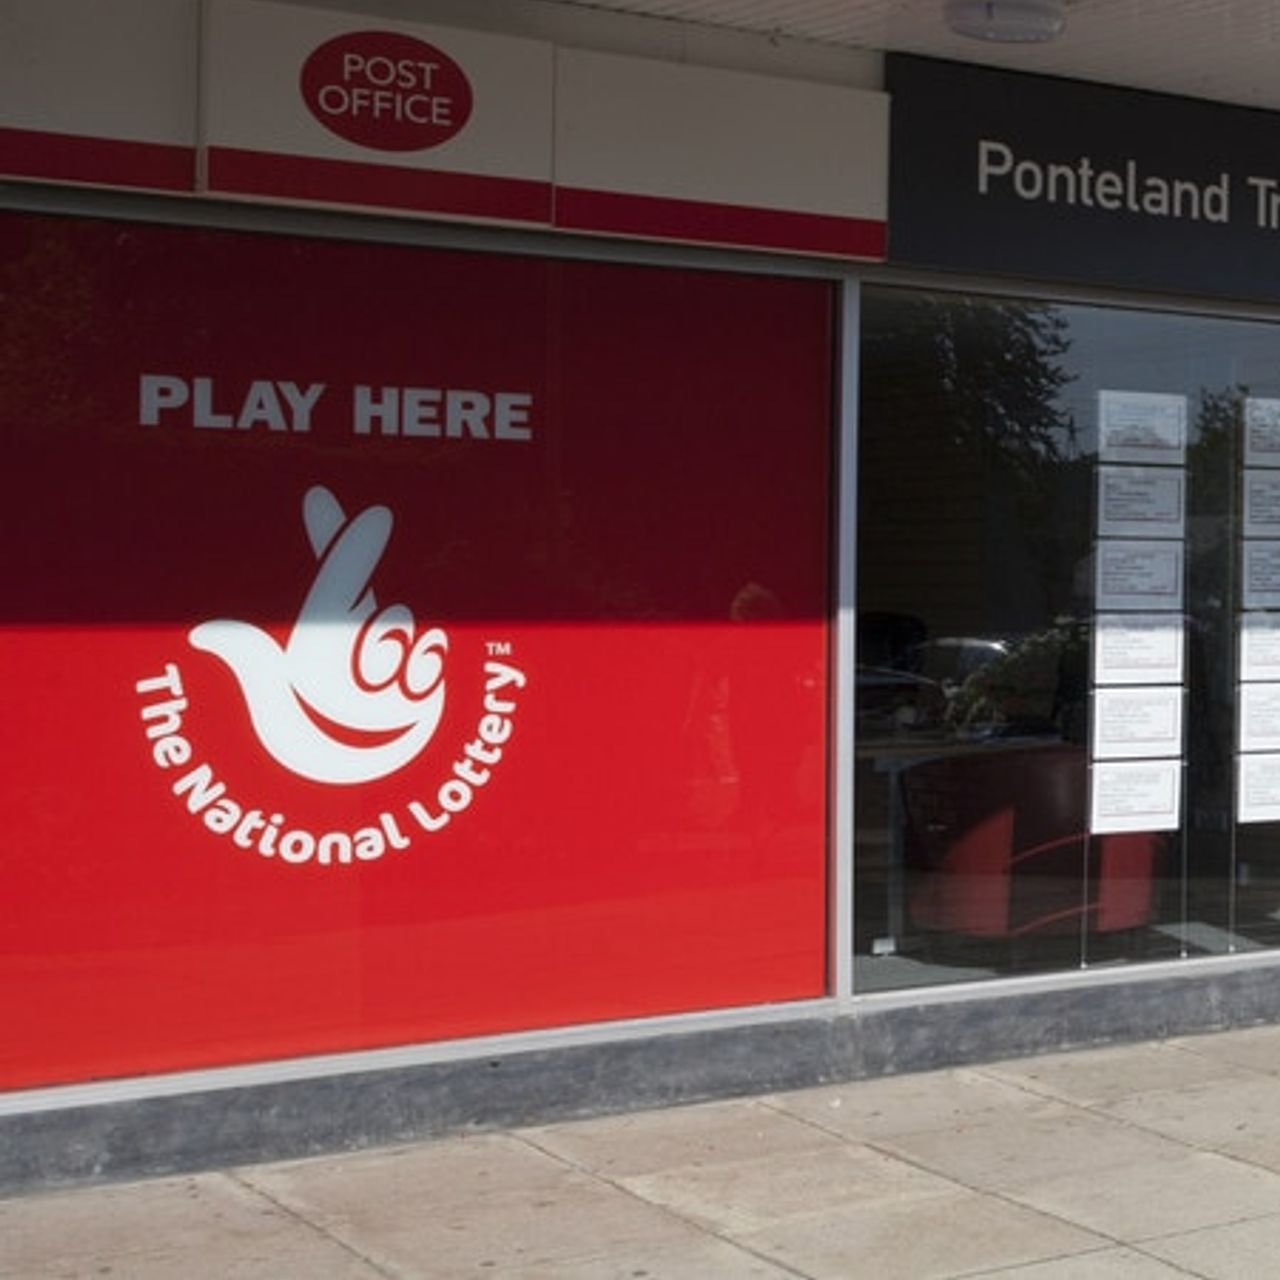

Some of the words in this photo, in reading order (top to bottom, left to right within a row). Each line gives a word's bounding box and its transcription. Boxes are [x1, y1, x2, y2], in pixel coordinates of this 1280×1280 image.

[317, 84, 453, 127] OFFICE
[341, 53, 440, 92] POST
[976, 138, 1231, 224] Ponteland
[138, 373, 327, 432] PLAY
[352, 385, 534, 441] HERE
[135, 662, 193, 769] The
[171, 762, 411, 866] National
[407, 659, 527, 832] Lottery
